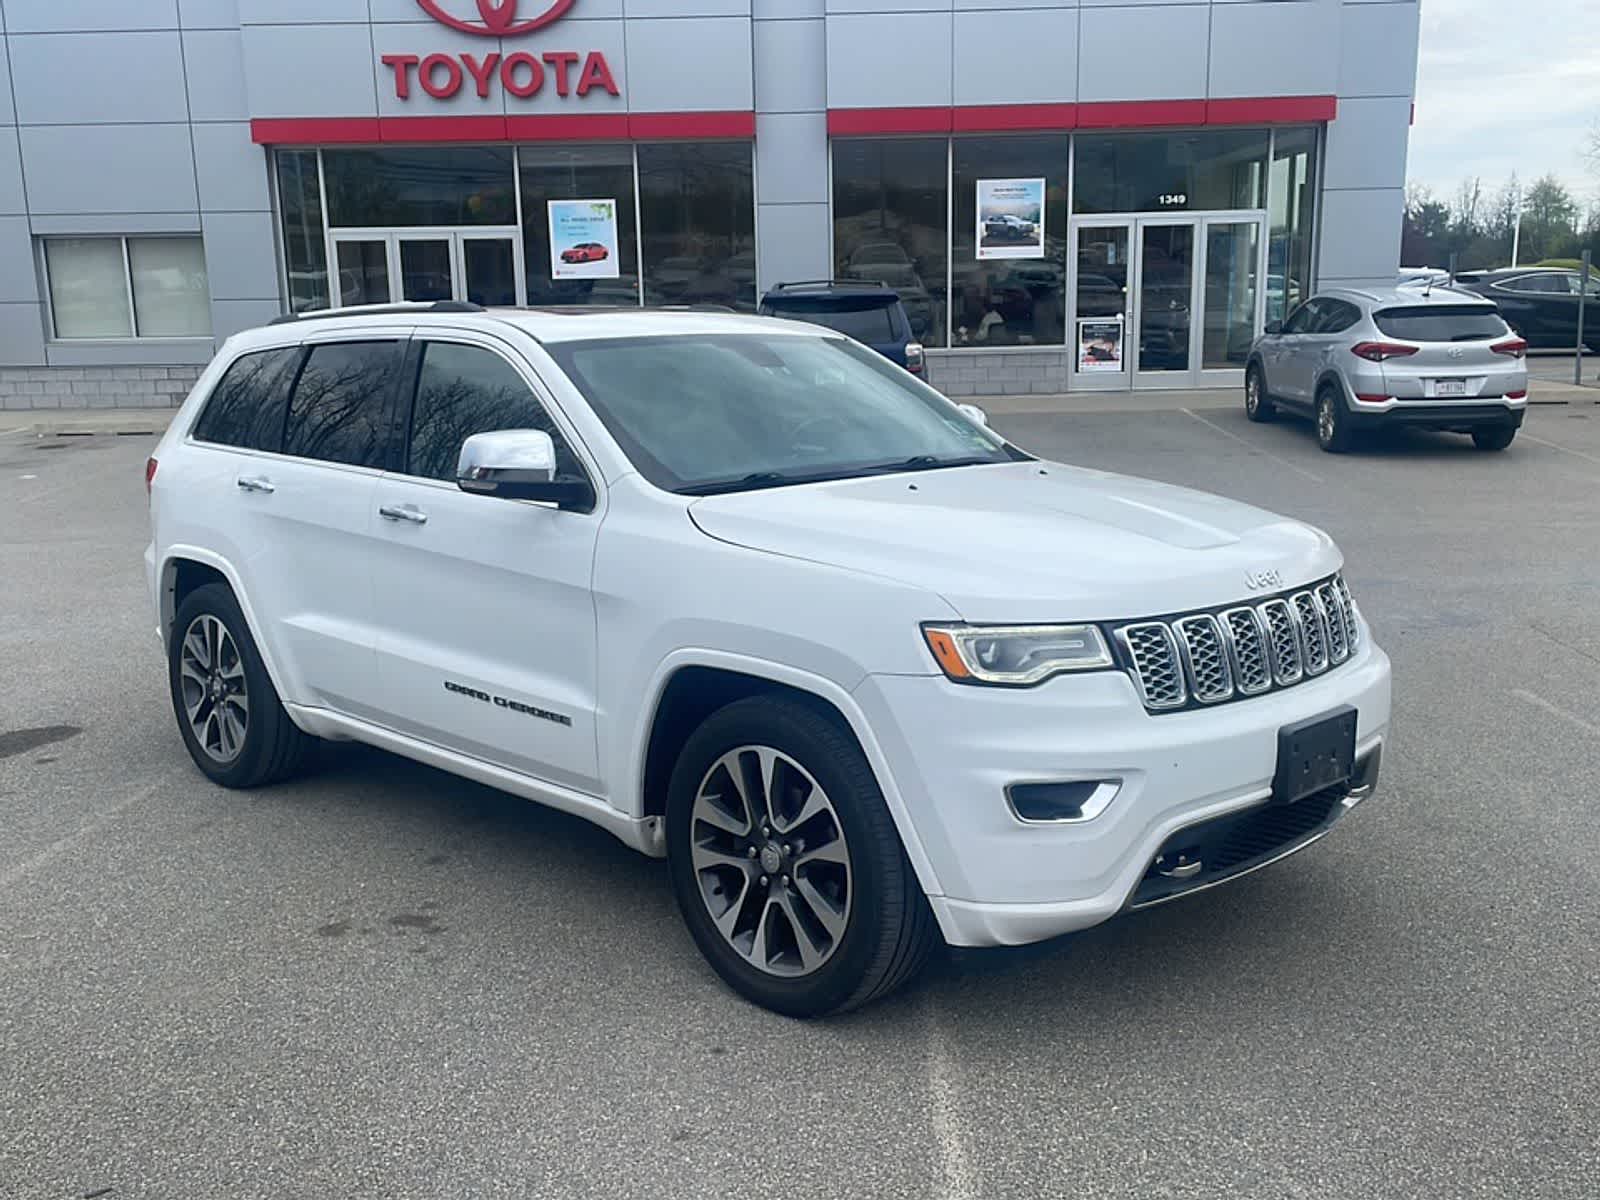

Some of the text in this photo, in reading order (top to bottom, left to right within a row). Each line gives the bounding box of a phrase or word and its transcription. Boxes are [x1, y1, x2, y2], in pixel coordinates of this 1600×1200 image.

[381, 52, 620, 100] TOYOTA
[1159, 194, 1186, 205] 1349
[444, 681, 572, 727] GRAND CHEROKEE
